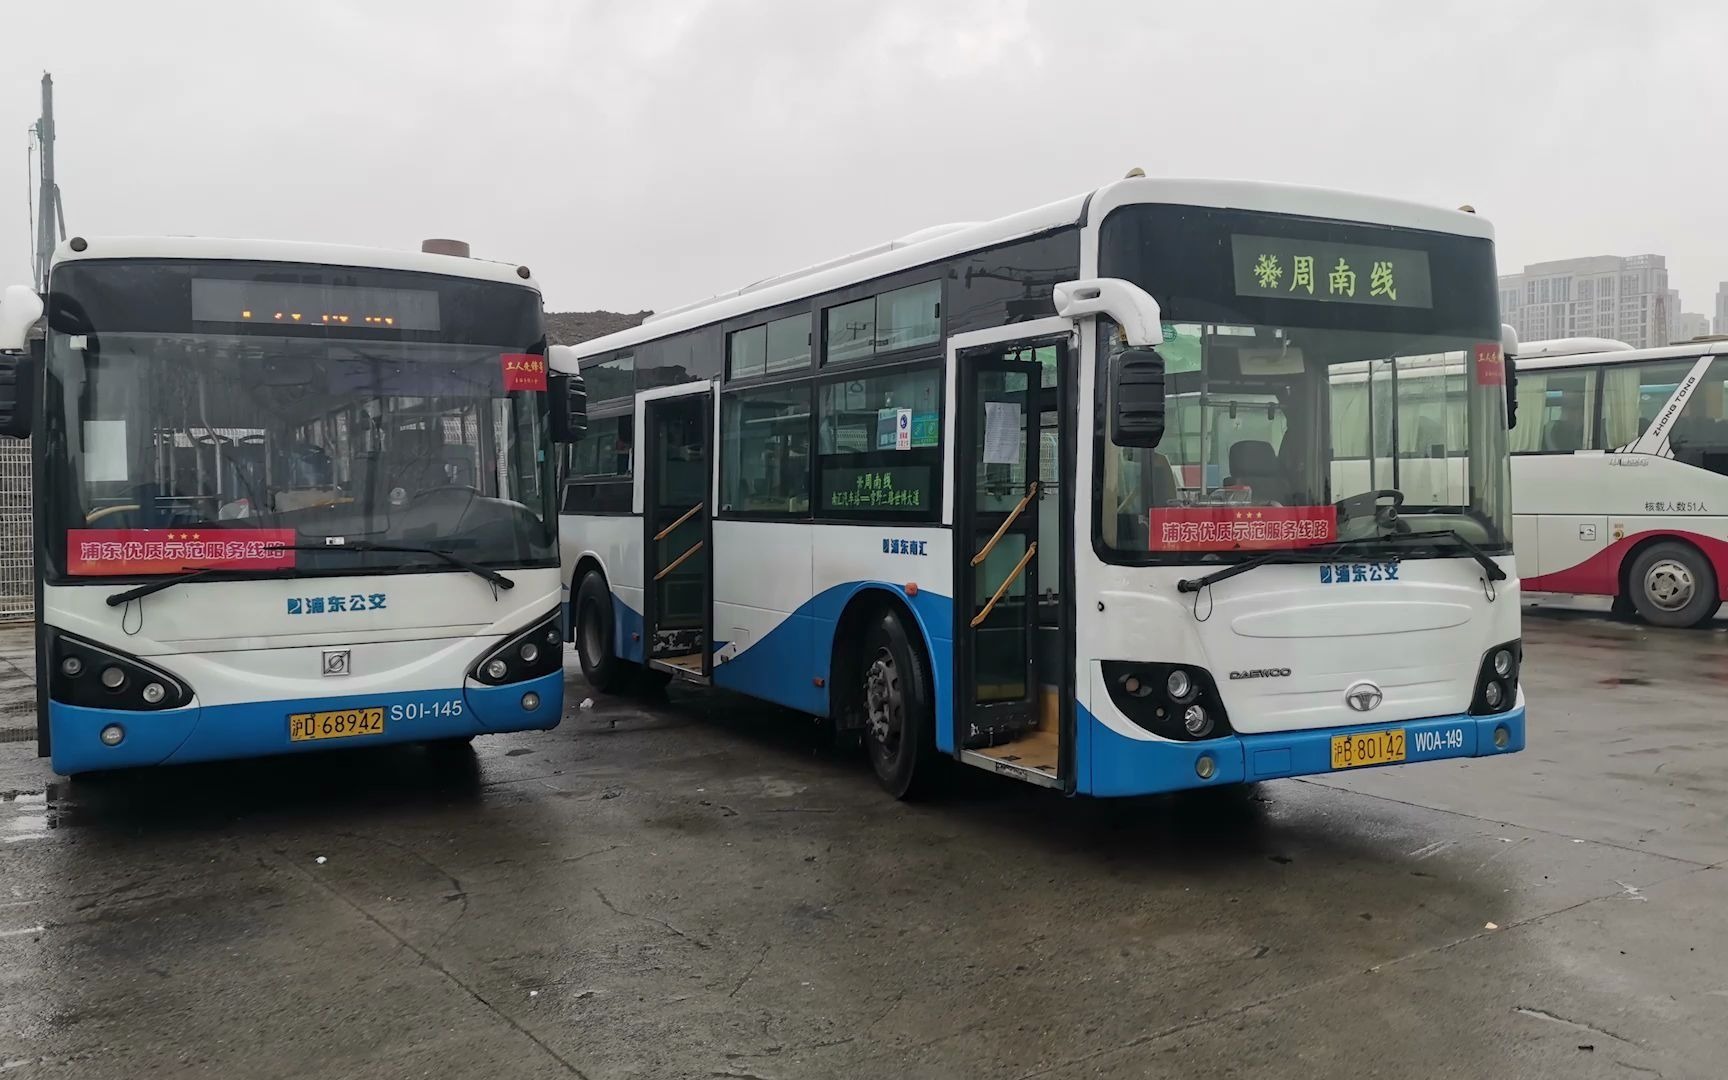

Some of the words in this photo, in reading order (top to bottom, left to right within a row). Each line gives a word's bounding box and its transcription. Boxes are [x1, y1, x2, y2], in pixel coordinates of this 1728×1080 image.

[1289, 254, 1398, 301] 周南线
[1652, 403, 1677, 437] ZHONG
[1675, 376, 1696, 402] TONG
[864, 472, 892, 490] 周南线
[1645, 501, 1708, 512] 核载人数51人
[1162, 519, 1330, 542] 浦东优质示范服务线路
[80, 541, 286, 560] 浦东优质示范服务线路
[890, 538, 928, 556] 浦东南汇
[1334, 559, 1399, 583] 浦东公交
[305, 593, 387, 614] 浦东公交
[1229, 667, 1292, 680] DAEWOO
